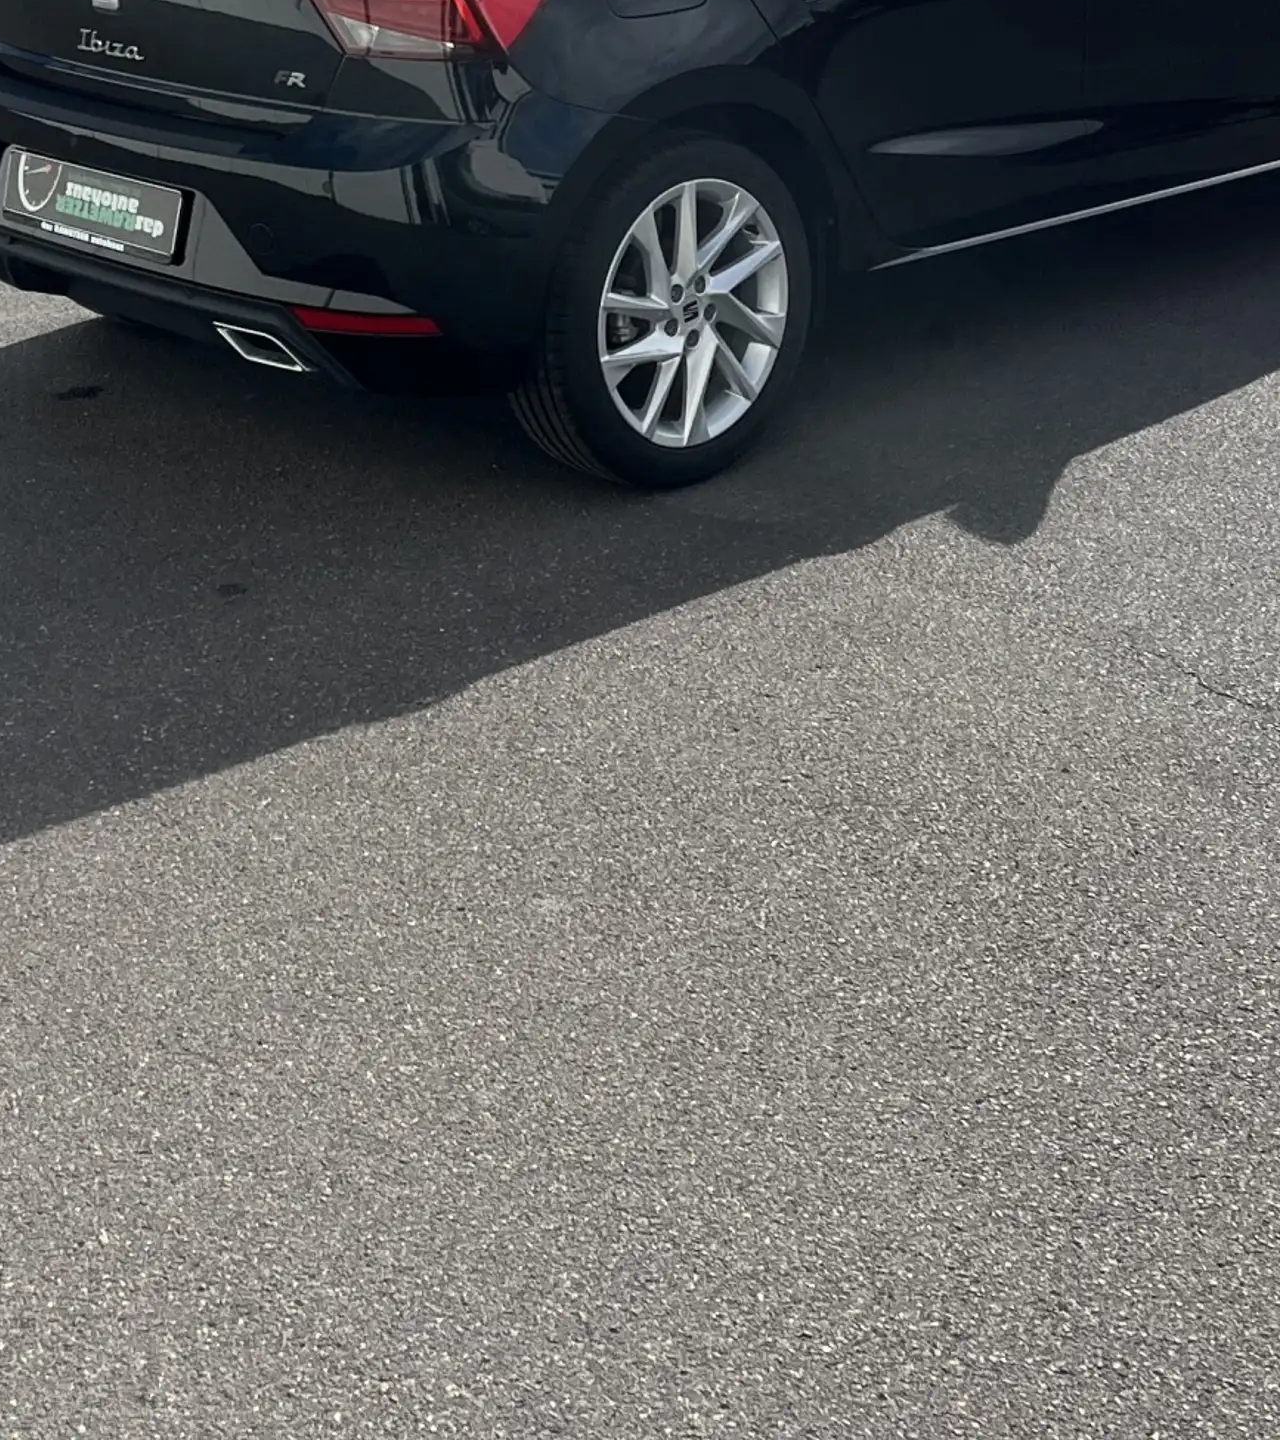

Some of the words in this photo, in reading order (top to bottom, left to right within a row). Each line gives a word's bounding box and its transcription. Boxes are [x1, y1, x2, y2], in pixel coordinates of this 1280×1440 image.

[77, 28, 144, 60] Ibiza
[274, 70, 306, 88] FR
[65, 181, 140, 214] autohaus
